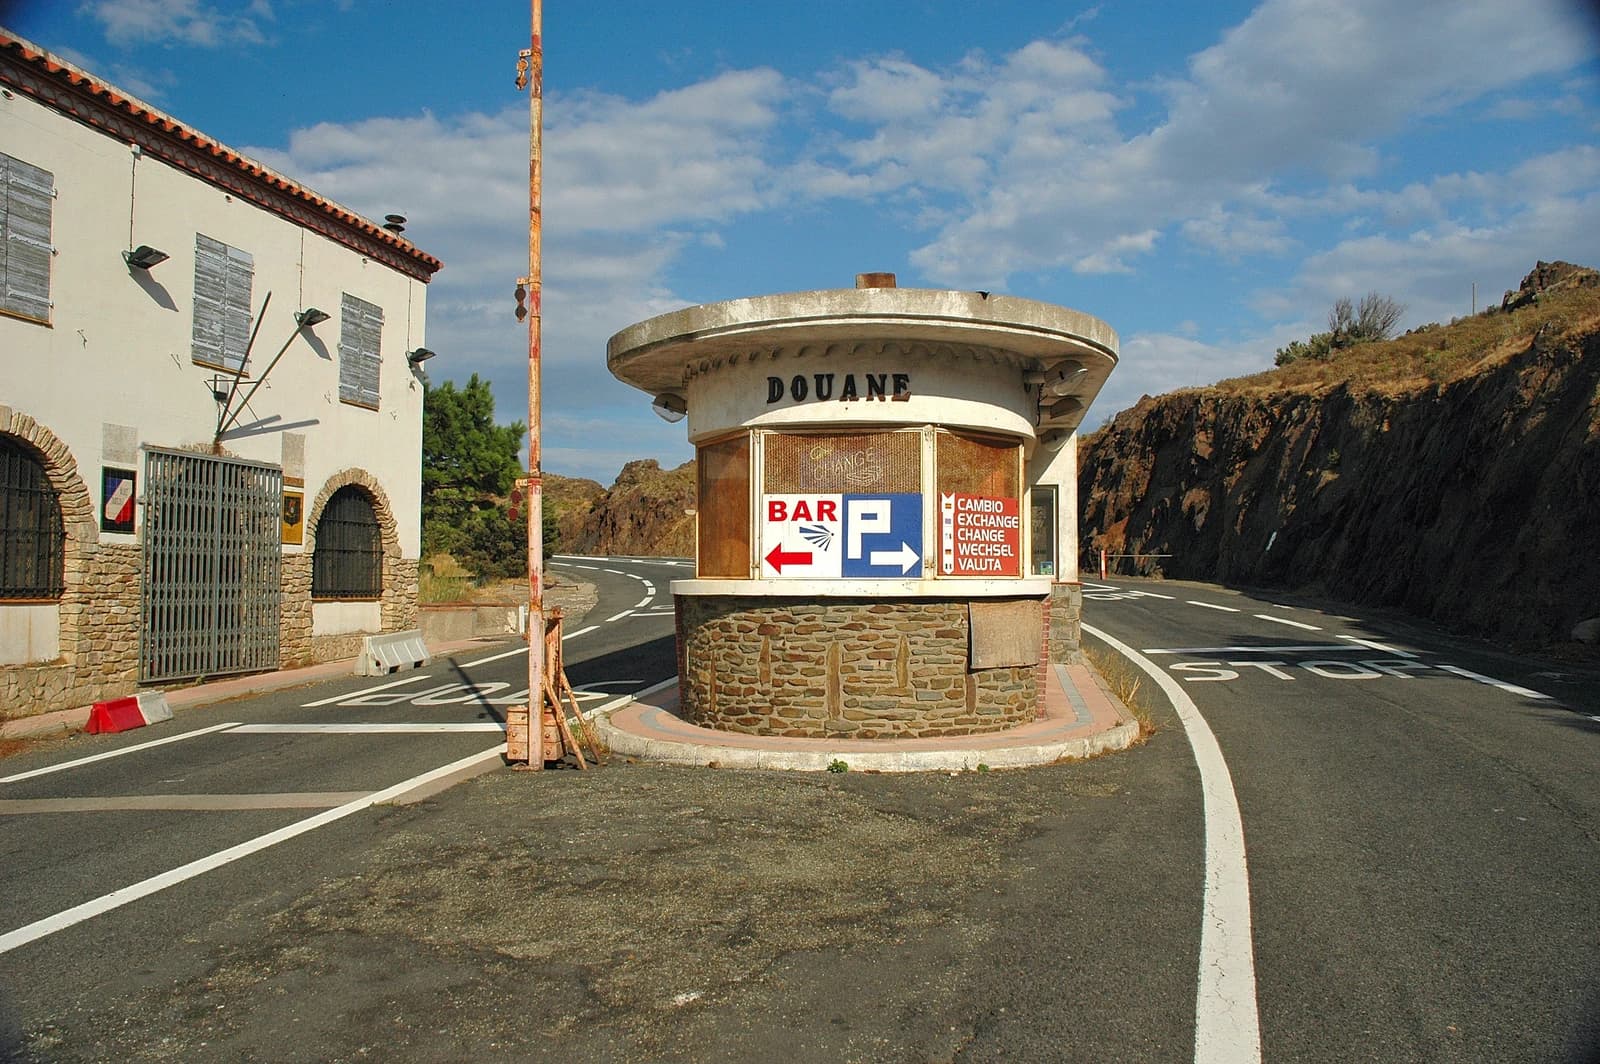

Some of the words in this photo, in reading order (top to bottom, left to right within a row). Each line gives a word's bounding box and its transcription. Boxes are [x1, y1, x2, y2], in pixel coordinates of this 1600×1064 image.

[767, 373, 912, 404] DOUANE
[768, 500, 838, 522] BAR
[957, 498, 1004, 513] CAMBIO
[957, 513, 1019, 529] EXCHANGE
[847, 499, 892, 560] P
[957, 528, 1005, 542] CHANGE
[958, 543, 1014, 557] WECHSEL
[958, 558, 1003, 571] VALUTA
[1169, 659, 1435, 681] STOP
